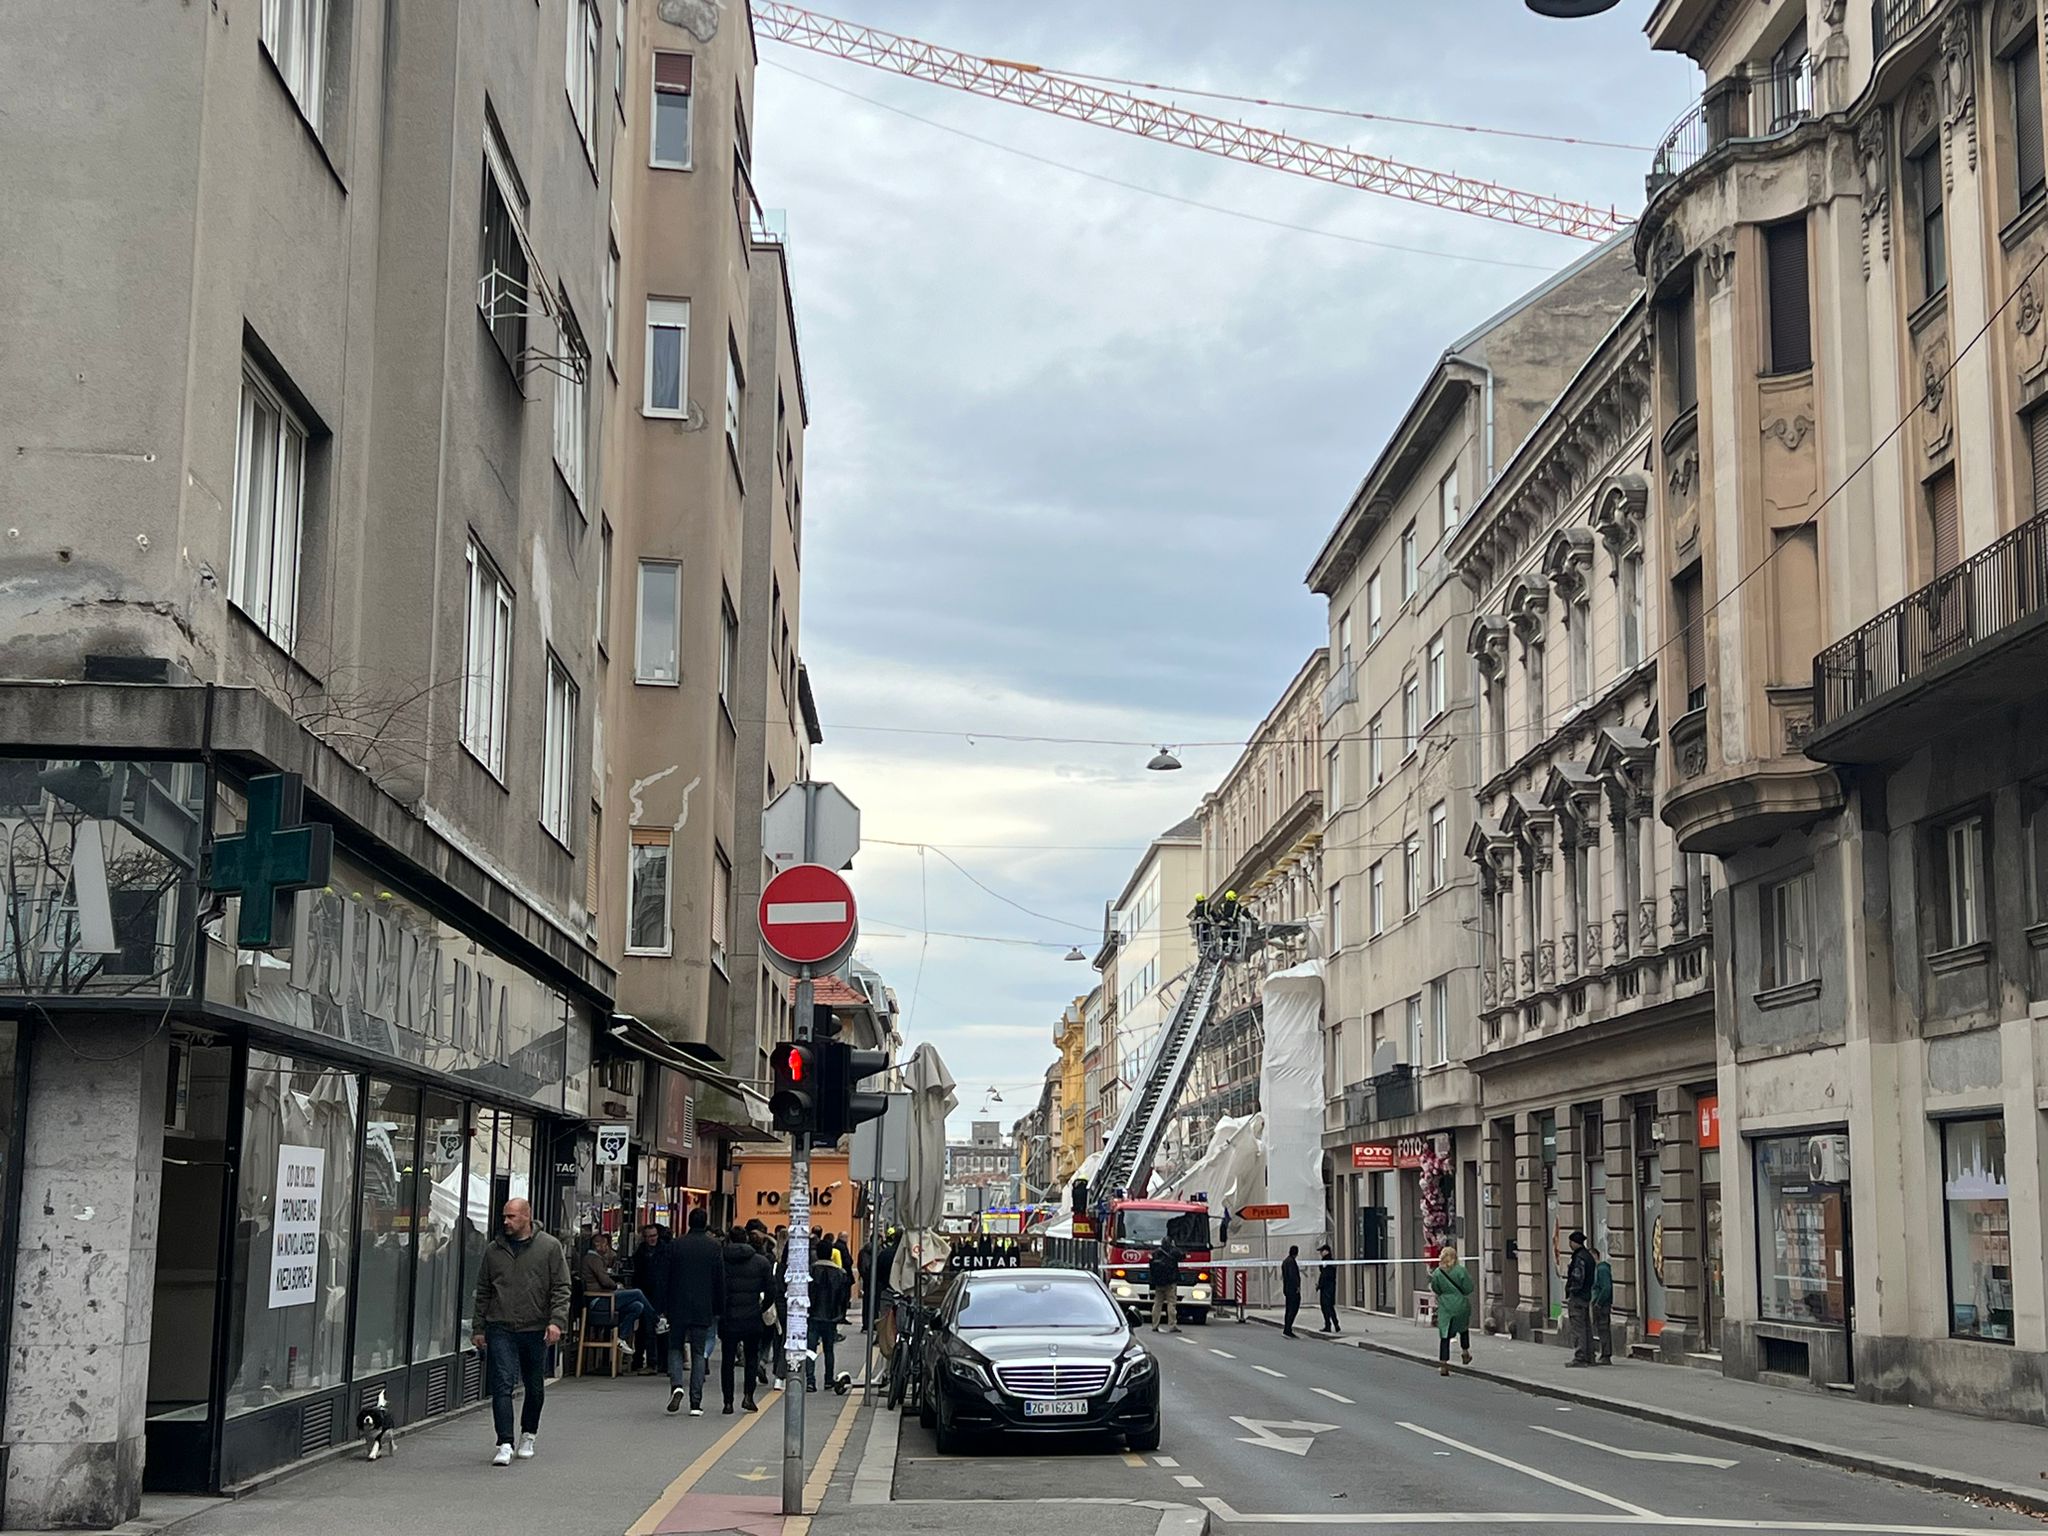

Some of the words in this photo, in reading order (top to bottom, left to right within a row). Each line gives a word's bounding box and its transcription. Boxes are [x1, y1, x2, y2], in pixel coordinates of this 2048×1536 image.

[1355, 1147, 1392, 1156] FOTO
[1398, 1136, 1421, 1157] FOTO
[952, 1256, 1017, 1267] CENTAR
[1032, 1403, 1044, 1414] ZG
